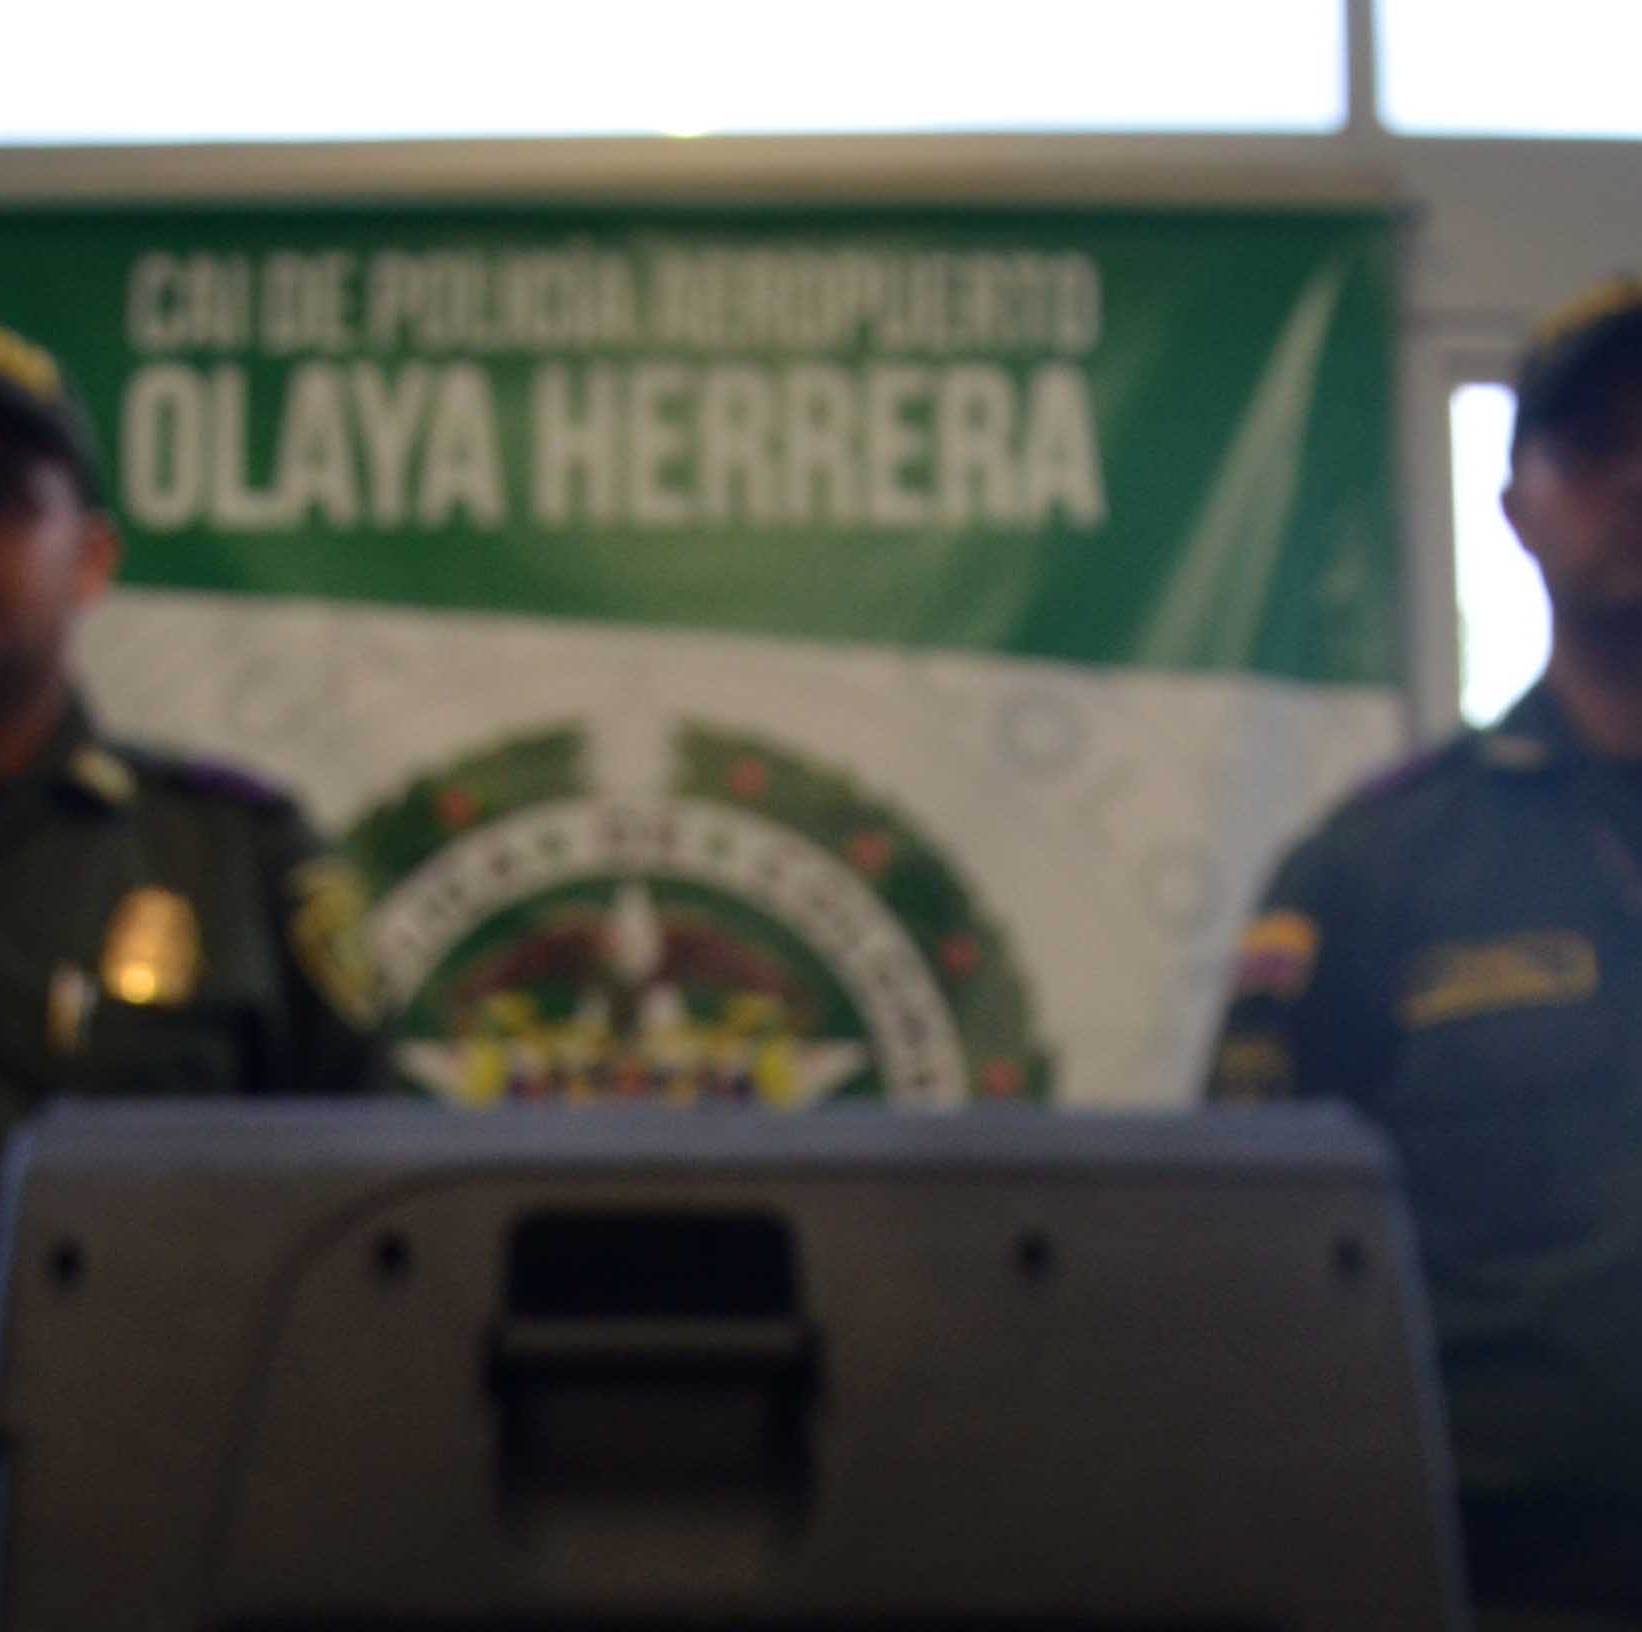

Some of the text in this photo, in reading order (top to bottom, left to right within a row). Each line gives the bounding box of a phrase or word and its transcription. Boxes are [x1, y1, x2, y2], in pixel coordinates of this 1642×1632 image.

[127, 252, 246, 350] CAI
[260, 252, 350, 350] DE
[652, 248, 1103, 356] AEROPUERTO
[121, 361, 1107, 526] OLAYA HERRERA
